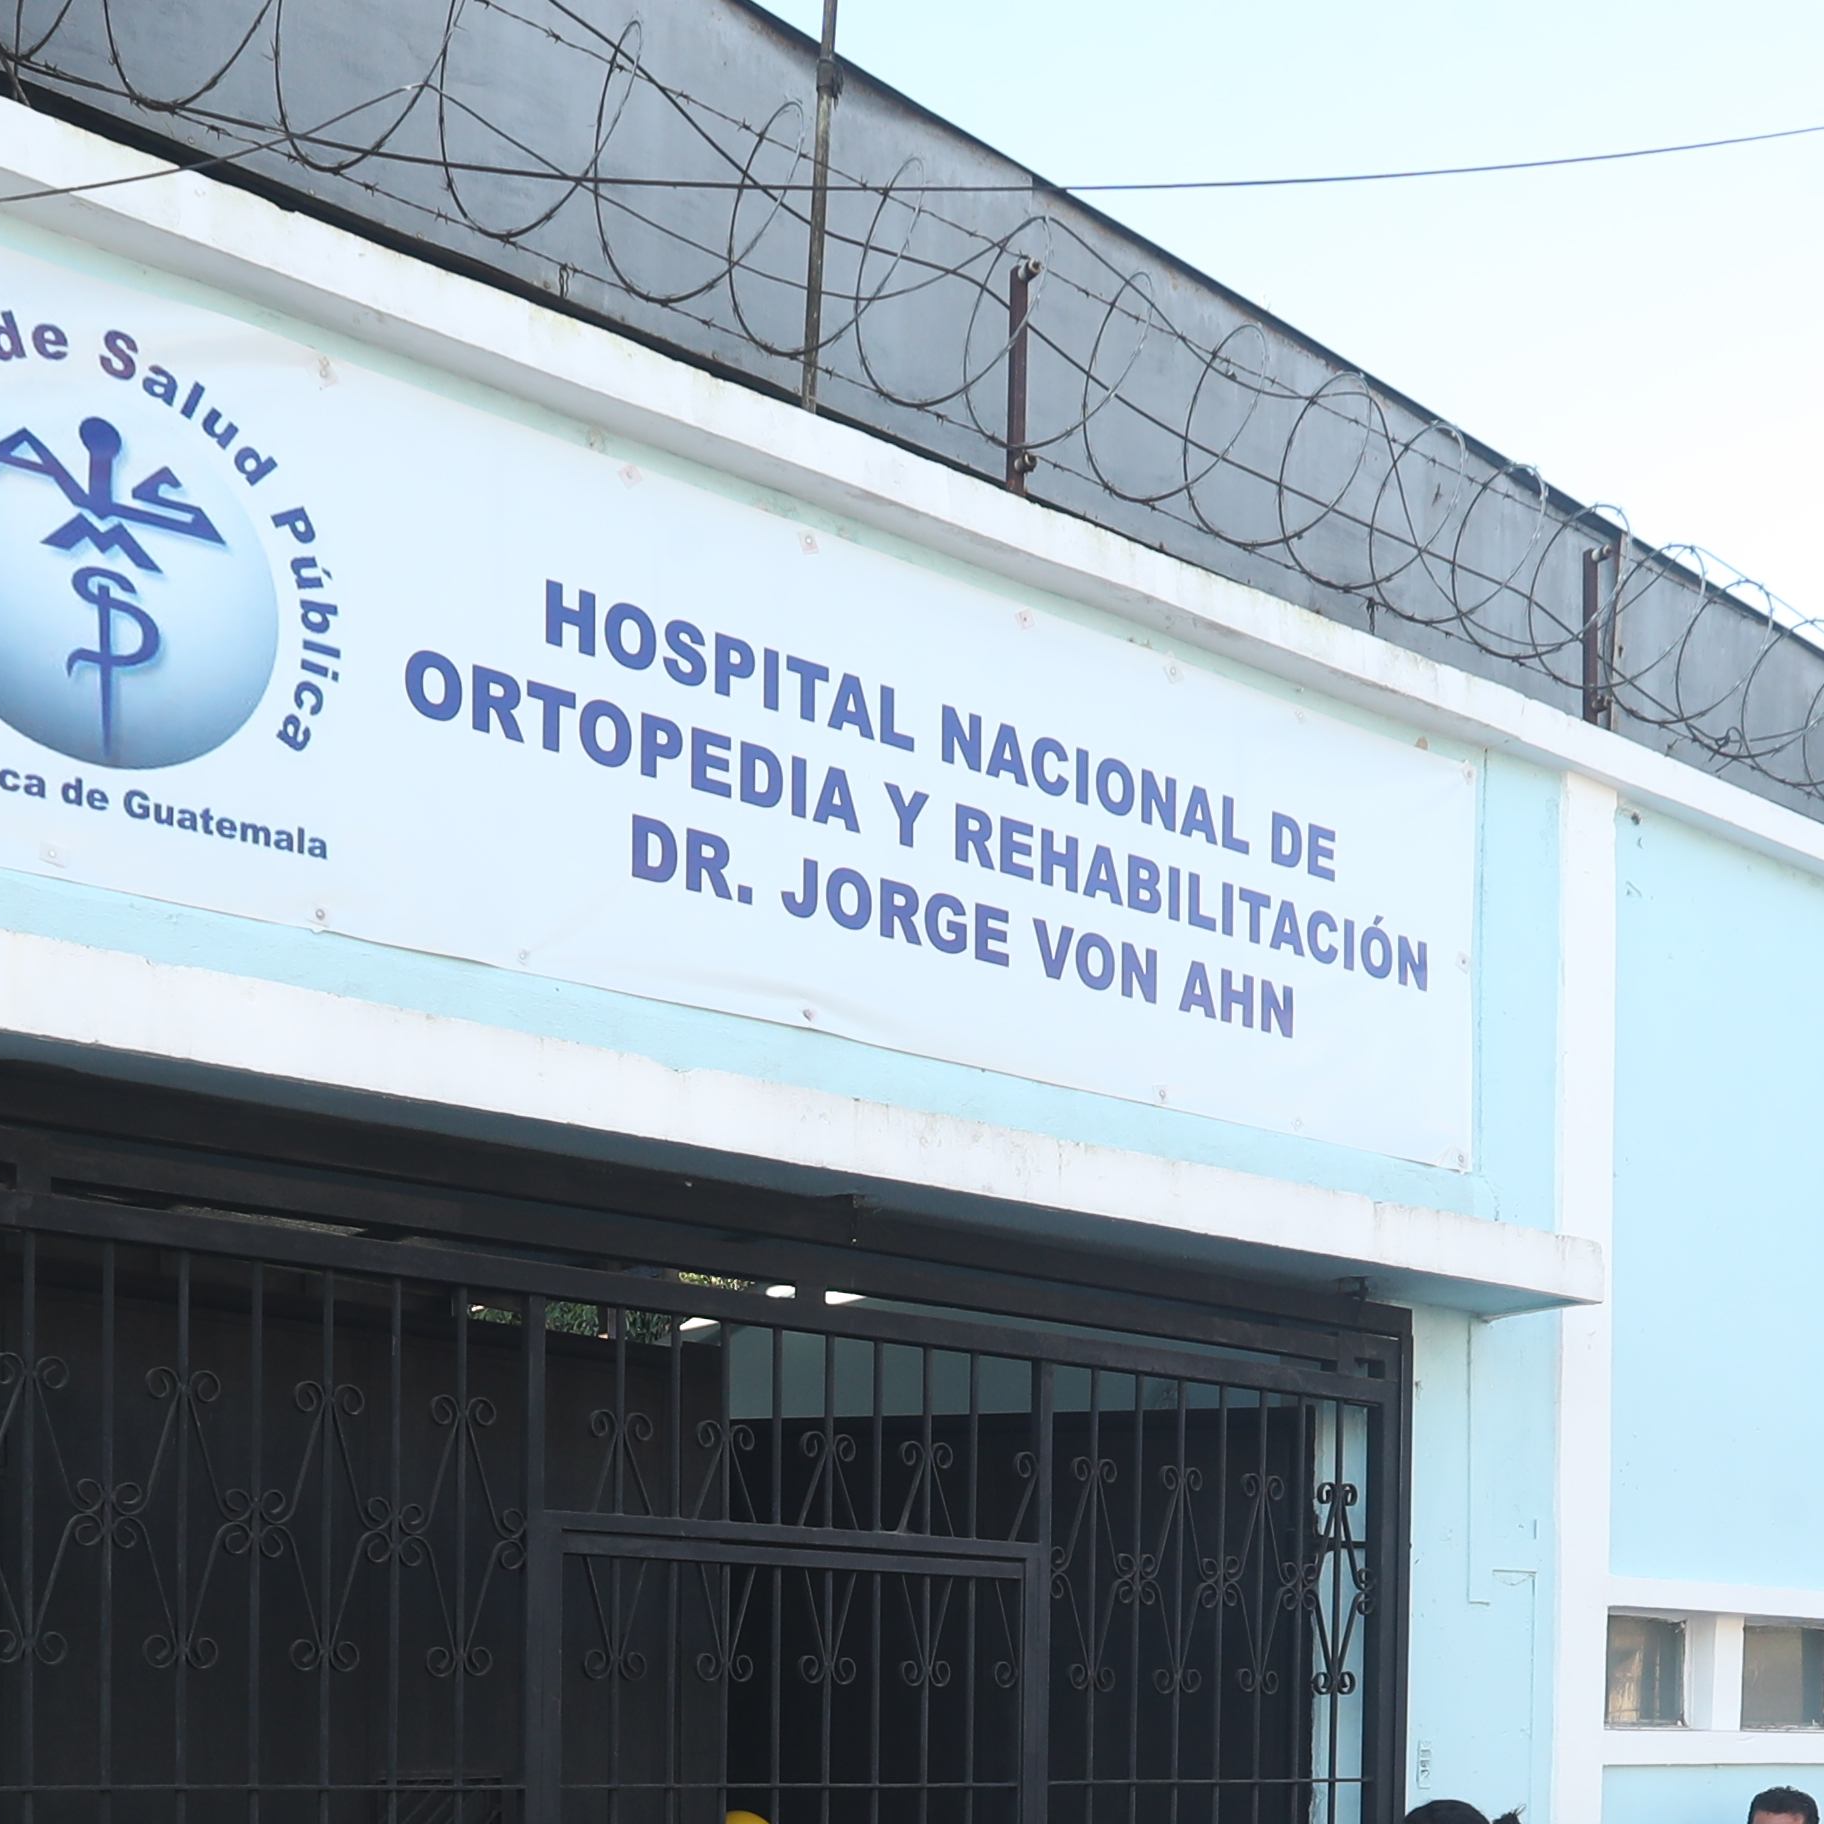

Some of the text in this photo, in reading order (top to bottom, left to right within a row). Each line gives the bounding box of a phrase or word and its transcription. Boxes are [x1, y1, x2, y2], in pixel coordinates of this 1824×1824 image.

[99, 329, 279, 487] Salud
[270, 506, 342, 752] Pública
[61, 777, 110, 812] de
[123, 789, 328, 860] Guatemala
[404, 650, 1428, 992] ORTOPEDIA Y REHABILITACIÓN
[545, 578, 1336, 882] HOSPITAL NACIONAL DE
[631, 813, 1294, 1039] DR. JORGE VON AHN
